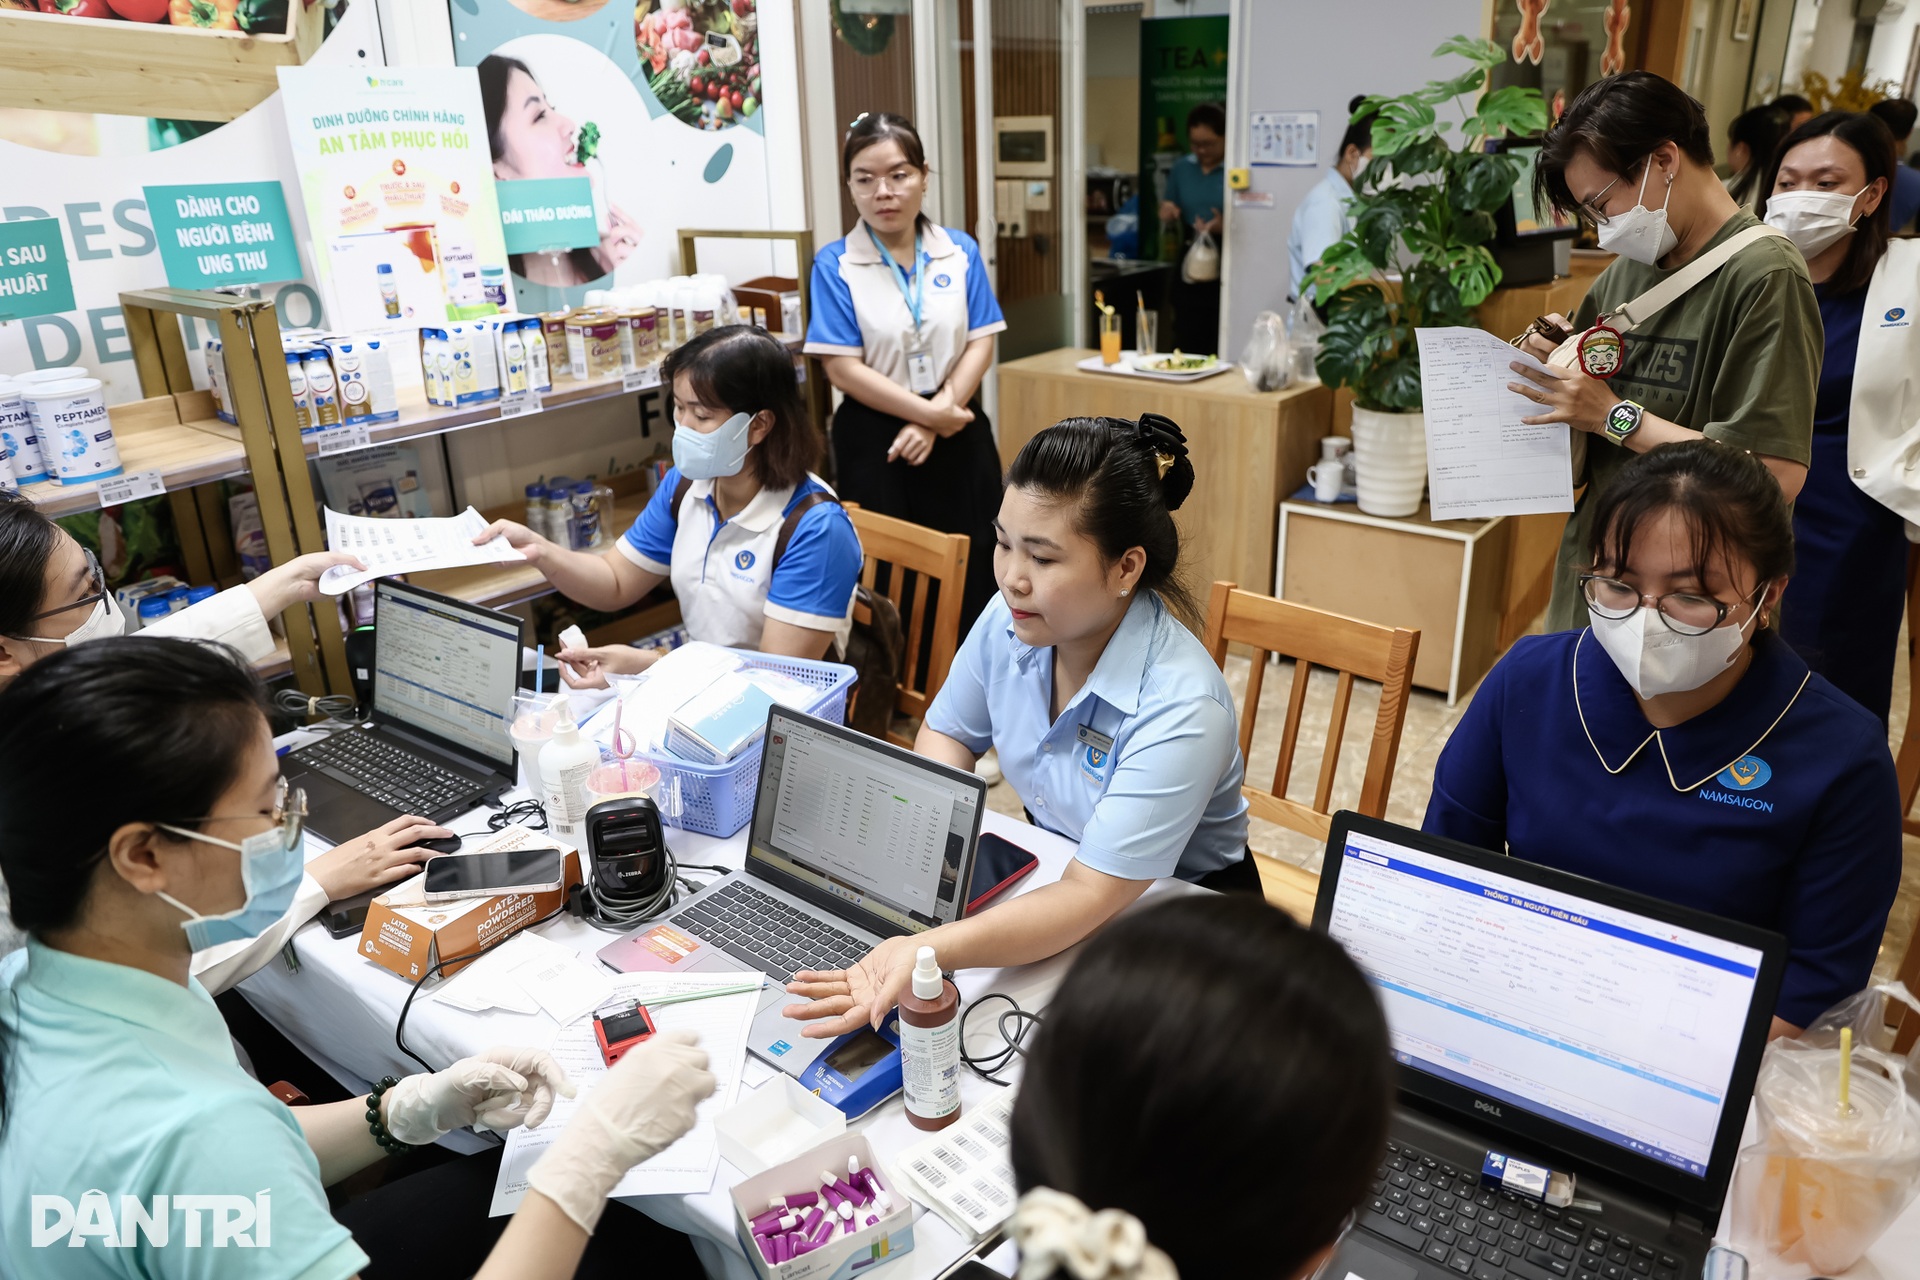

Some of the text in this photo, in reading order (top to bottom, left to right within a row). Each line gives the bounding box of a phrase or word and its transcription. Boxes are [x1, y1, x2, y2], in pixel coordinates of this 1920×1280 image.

[1158, 47, 1208, 70] TEA
[312, 113, 344, 130] DINH
[318, 135, 345, 156] AN
[348, 129, 387, 151] TÂM
[392, 130, 437, 151] PHỤC
[176, 194, 260, 219] DÀNH CHO
[176, 219, 275, 248] NGƯỜI BỆNH
[9, 244, 47, 266] SAU
[197, 249, 270, 276] UNG THƯ
[1699, 788, 1774, 814] NAMSAIGON
[625, 870, 642, 878] ZEBRA
[488, 893, 520, 916] LATEX
[1483, 888, 1509, 902] THÔNG
[1509, 896, 1522, 906] TIN
[391, 917, 409, 932] LATEX
[477, 894, 535, 934] POWDERED
[478, 902, 537, 943] EXAMINATION GLOVES
[382, 922, 413, 943] POWDERED
[410, 966, 418, 976] M
[1474, 1099, 1502, 1117] DELL
